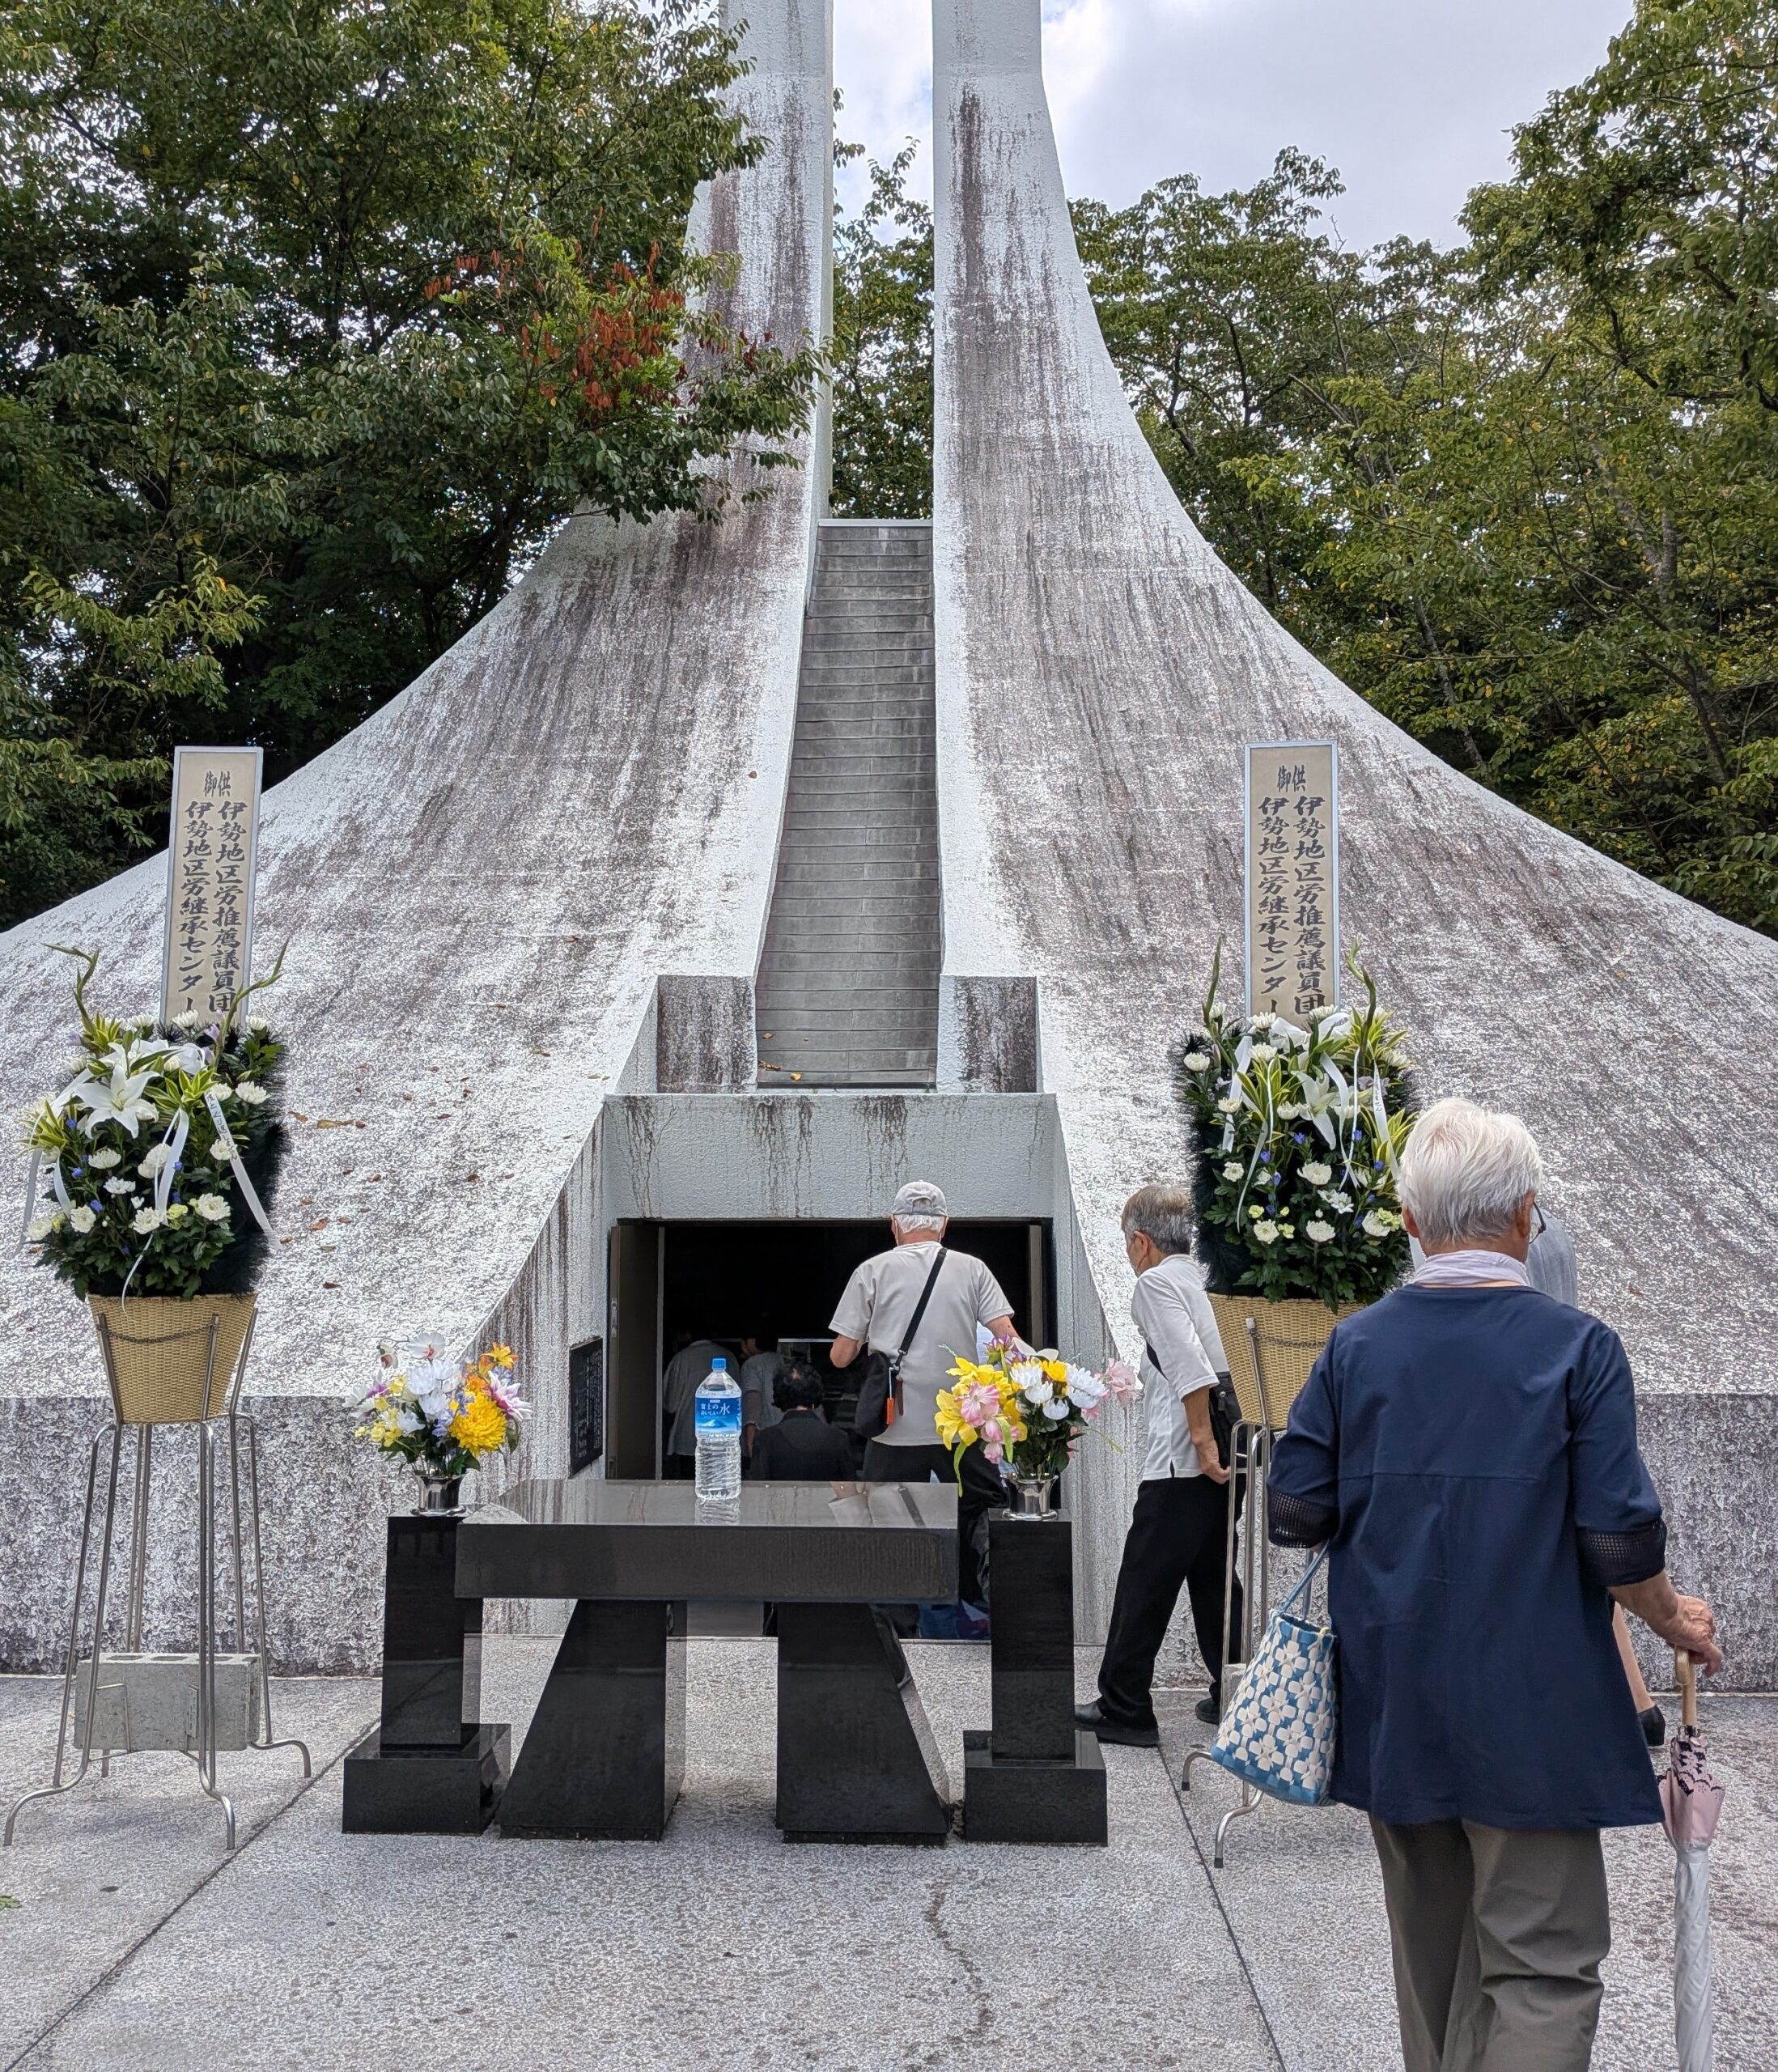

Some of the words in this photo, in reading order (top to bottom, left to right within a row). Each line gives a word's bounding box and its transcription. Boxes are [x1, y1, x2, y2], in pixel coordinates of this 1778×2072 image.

[208, 800, 248, 1013] 伊勢地区労推薦議員団
[1292, 796, 1326, 1014] 伊勢地区労推薦議員団
[719, 1403, 731, 1416] 水
